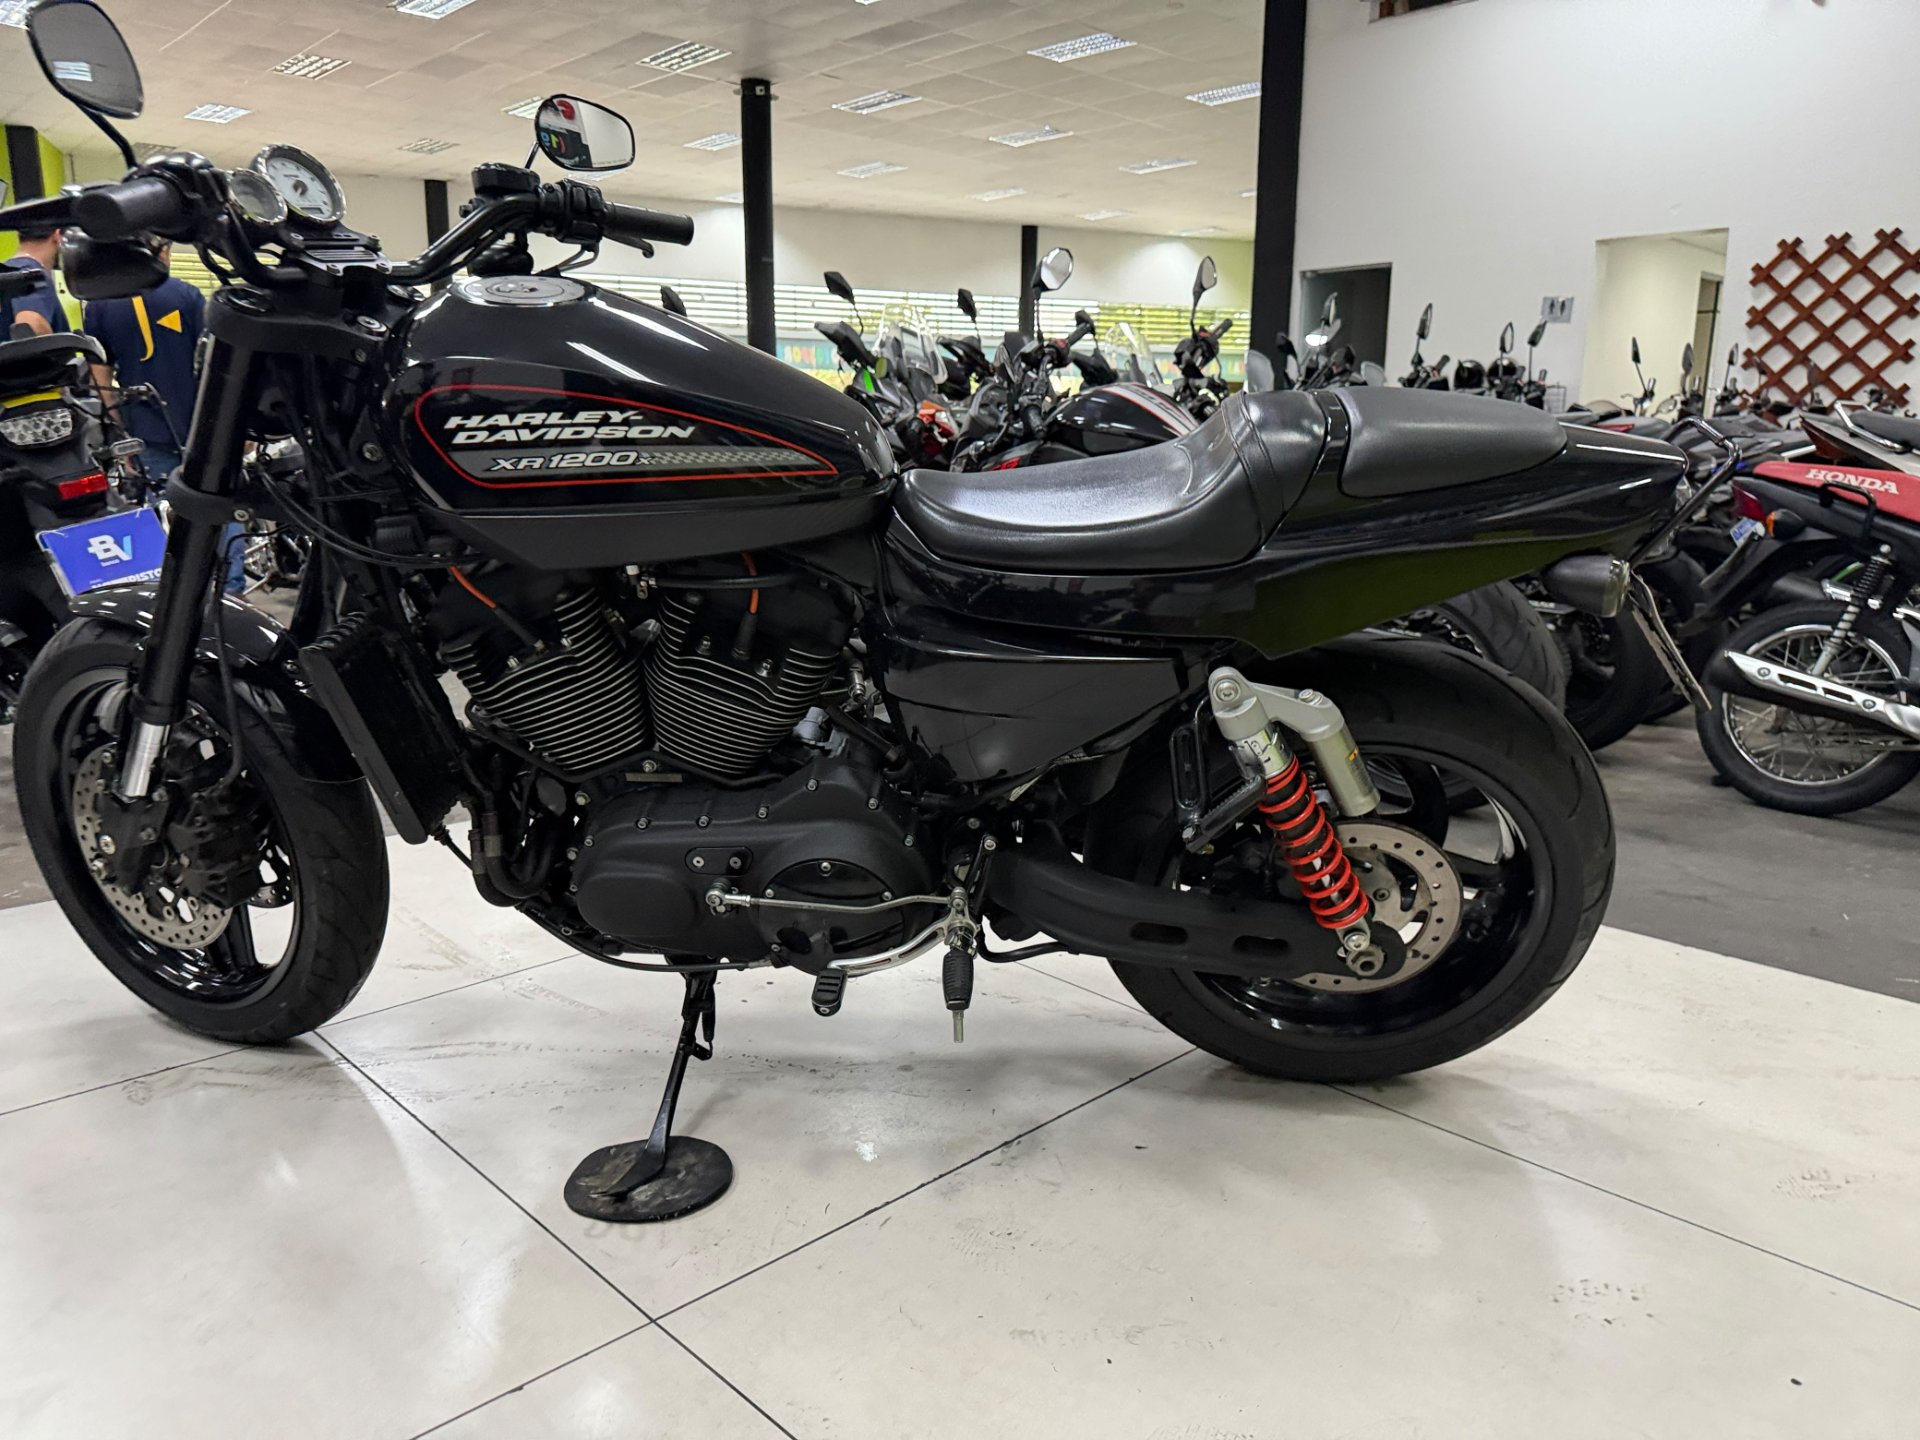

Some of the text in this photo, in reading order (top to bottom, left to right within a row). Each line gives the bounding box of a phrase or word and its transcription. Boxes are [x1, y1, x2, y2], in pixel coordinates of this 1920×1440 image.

[444, 411, 643, 429] HARLEY-
[452, 426, 696, 444] DAVIDSON
[1805, 469, 1899, 494] HONDA
